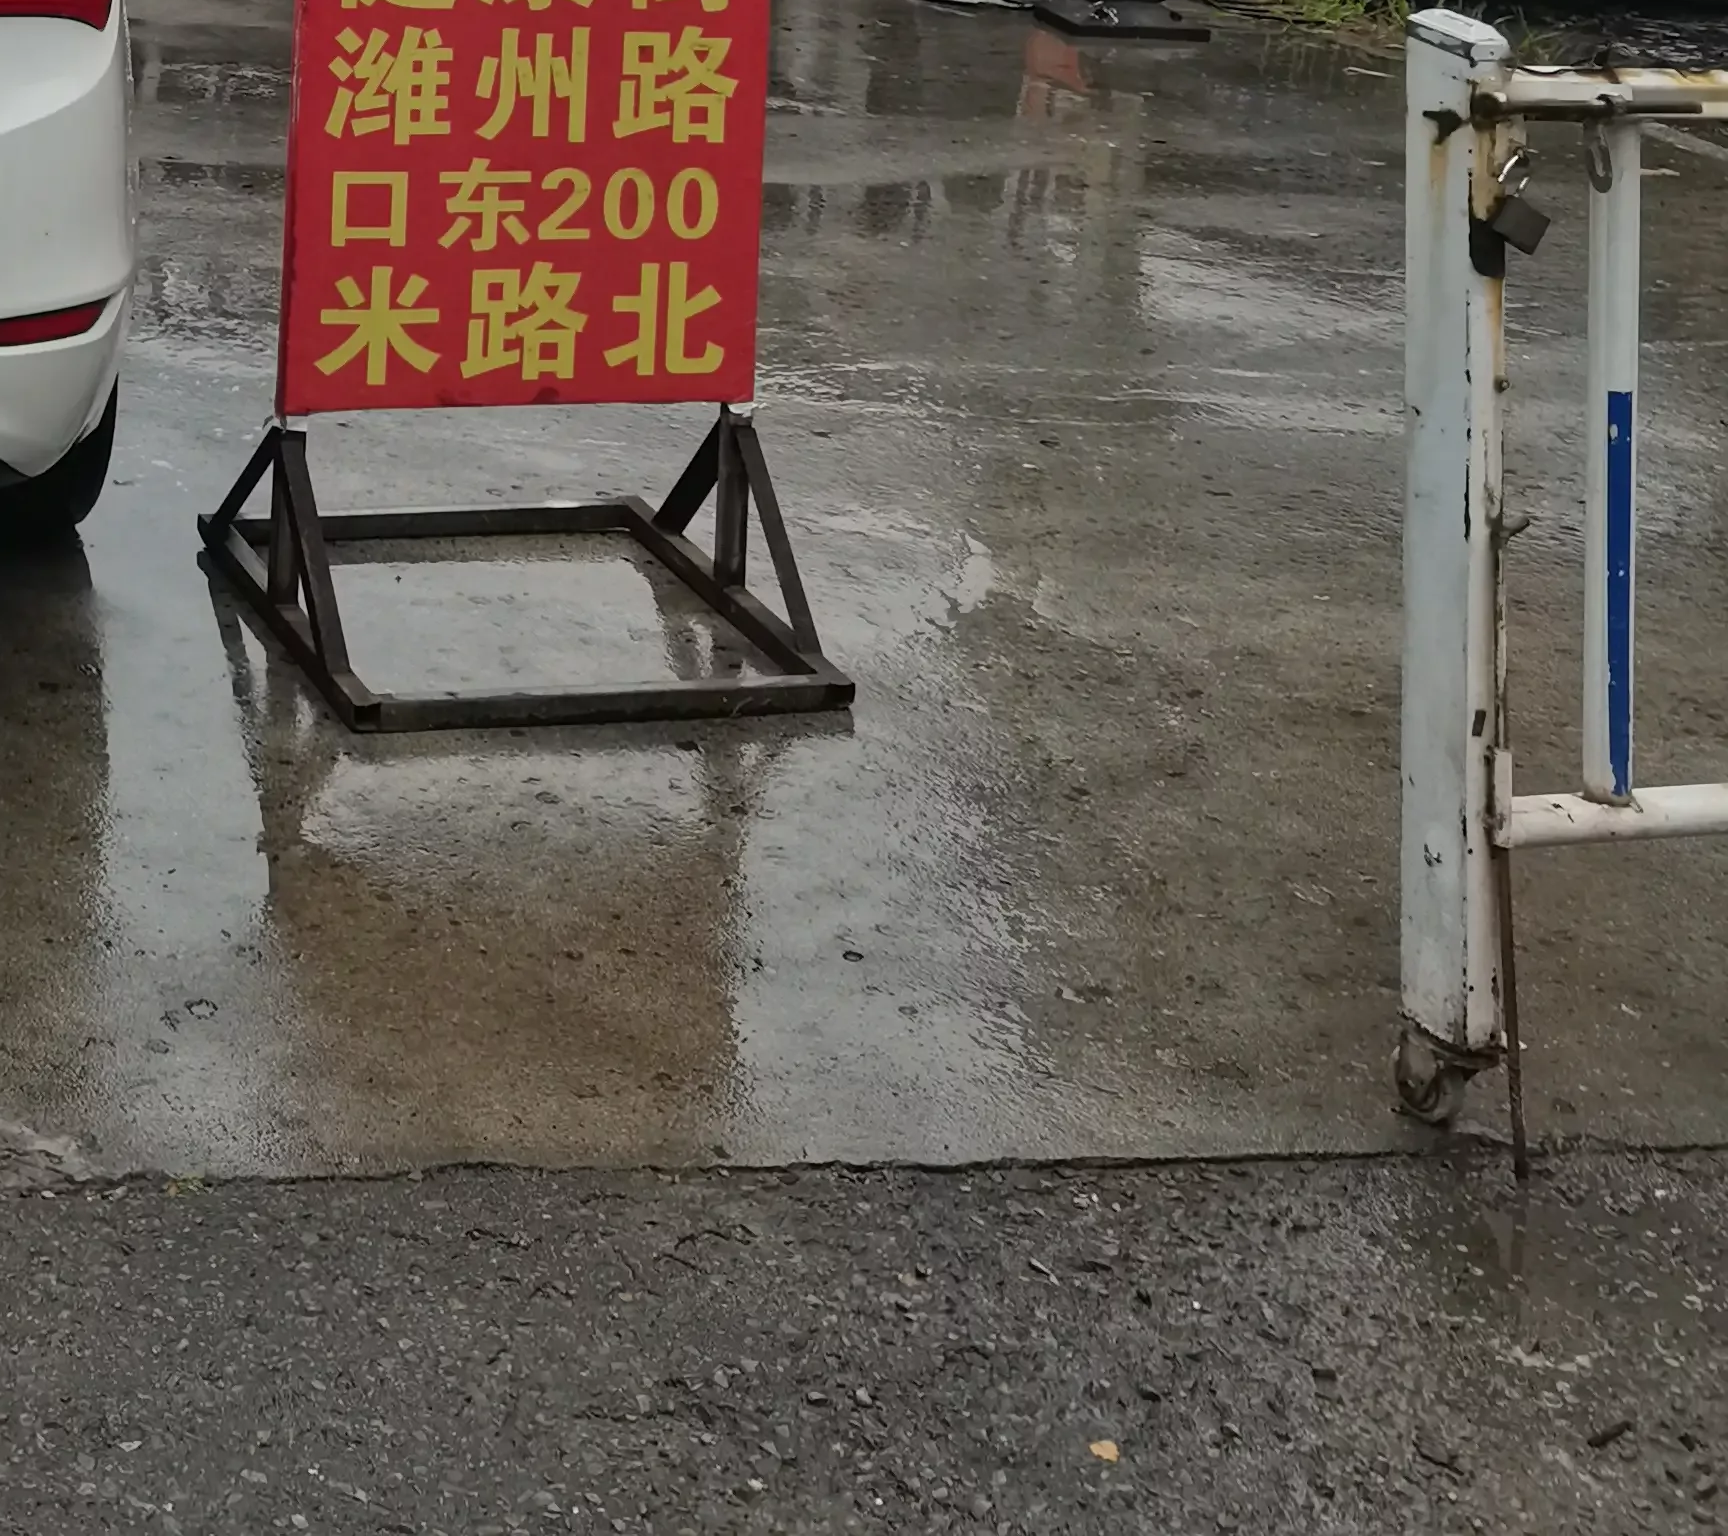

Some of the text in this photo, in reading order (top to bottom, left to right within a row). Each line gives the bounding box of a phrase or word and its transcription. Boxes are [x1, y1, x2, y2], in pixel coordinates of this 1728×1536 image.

[324, 26, 739, 145] 潍州路
[313, 261, 726, 386] 米路北
